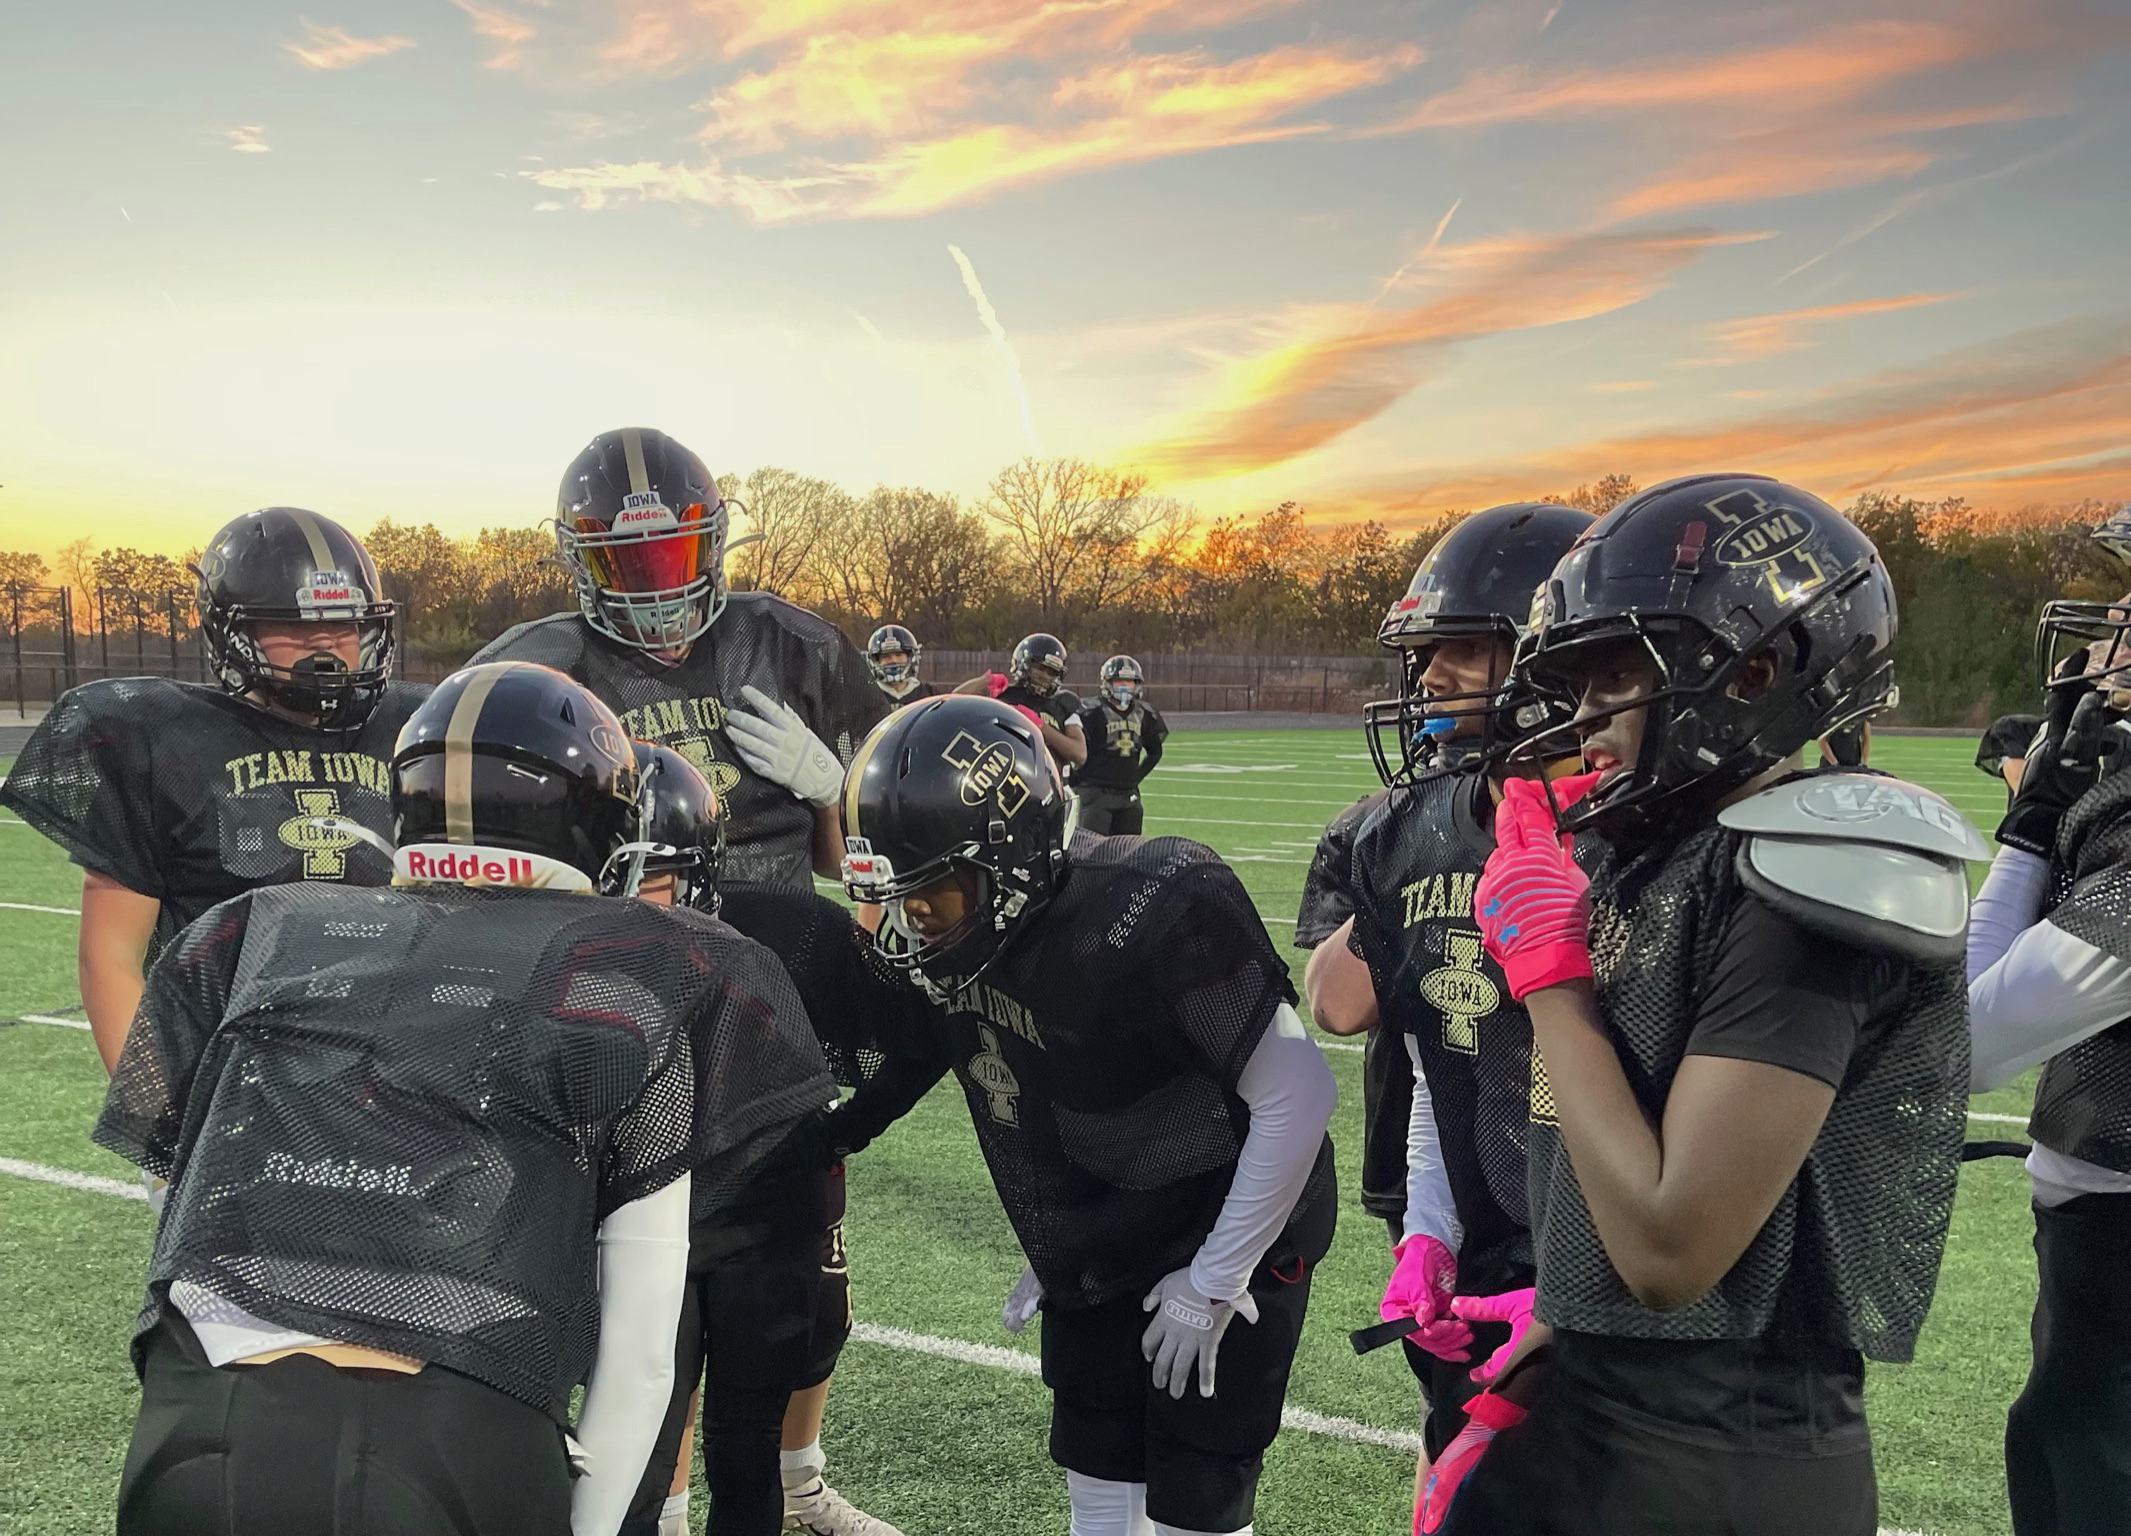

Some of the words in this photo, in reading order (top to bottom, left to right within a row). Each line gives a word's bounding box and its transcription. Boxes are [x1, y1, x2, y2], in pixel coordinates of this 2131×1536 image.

[627, 493, 657, 508] IOWA
[1730, 513, 1804, 559] IOWA
[313, 588, 349, 600] Riddell
[225, 750, 315, 796] TEAM
[319, 752, 390, 797] IOWA
[967, 750, 1010, 797] IOWA
[408, 851, 535, 885] Riddell
[1401, 872, 1476, 929] TEAM
[1439, 978, 1482, 1007] IOWA
[984, 984, 1048, 1051] IOWA
[1168, 1303, 1209, 1328] BATTLE
